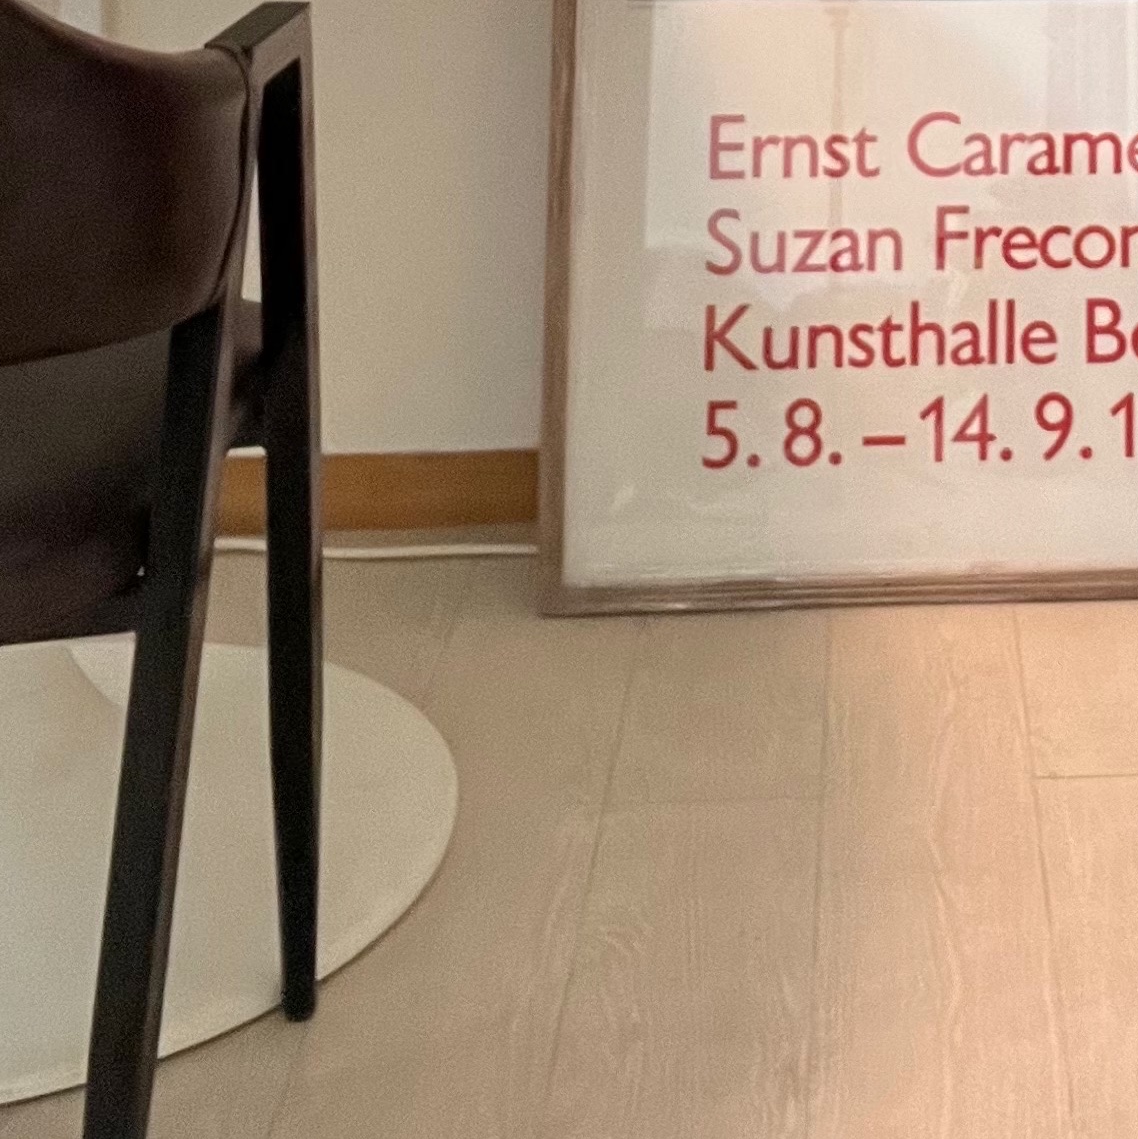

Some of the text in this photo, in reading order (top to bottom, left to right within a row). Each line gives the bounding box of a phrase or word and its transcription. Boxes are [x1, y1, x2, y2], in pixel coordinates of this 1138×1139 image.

[708, 114, 880, 180] Ernst
[705, 208, 903, 275] Suzan
[704, 299, 1058, 371] Kunsthalle
[702, 401, 760, 469] 5.
